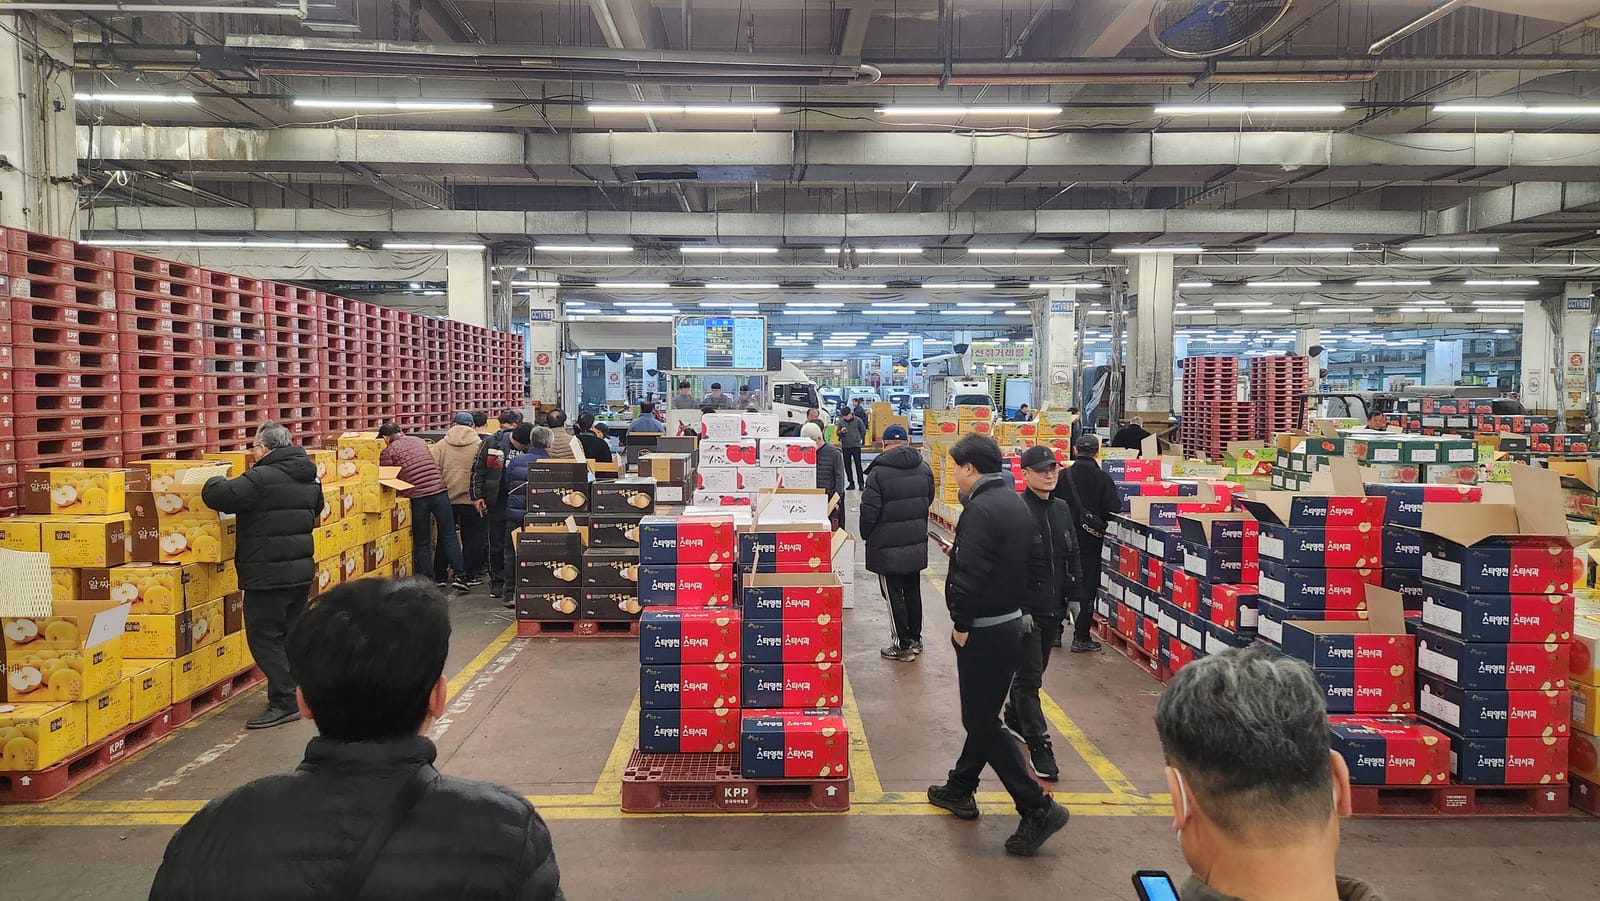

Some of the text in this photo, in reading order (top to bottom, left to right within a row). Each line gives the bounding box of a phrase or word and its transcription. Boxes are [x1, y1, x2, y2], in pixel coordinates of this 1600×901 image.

[1302, 505, 1353, 516] 스타영천 스타사과
[1245, 528, 1258, 537] 스타사
[653, 537, 703, 549] 스타영천 스타사과
[779, 542, 801, 552] 스타사과
[1300, 540, 1351, 551] 스타영천 스타사과
[1244, 560, 1258, 569] 스타사
[1481, 564, 1539, 576] 스타영천 스타사과
[652, 580, 702, 590] 스타영천 스타사과
[1301, 584, 1351, 595] 스타영천 스타사과
[757, 597, 810, 608] 스타영천 스타사과
[1483, 613, 1539, 625] 스타영천 스타사과
[655, 636, 708, 647] 스타영천 스타사과
[757, 635, 809, 646] 스타영천 스타사과
[1328, 646, 1382, 658] 스타영천 스타사과
[1479, 662, 1535, 674] 스타영천 스타사과
[655, 680, 708, 692] 스타영천 스타사과
[758, 679, 810, 691] 스타영천 스타사과
[1328, 685, 1382, 696] 스타영천 스타사과
[1480, 707, 1537, 719] 스타영천 스타사과
[654, 725, 707, 737] 스타영천 스타사과
[110, 739, 124, 754] KPP
[757, 747, 813, 759] 스타영천 스타사과
[1357, 754, 1415, 767] 스타영천 스타사과
[1478, 755, 1534, 767] 스타영천 스타사과
[724, 788, 749, 798] KPP
